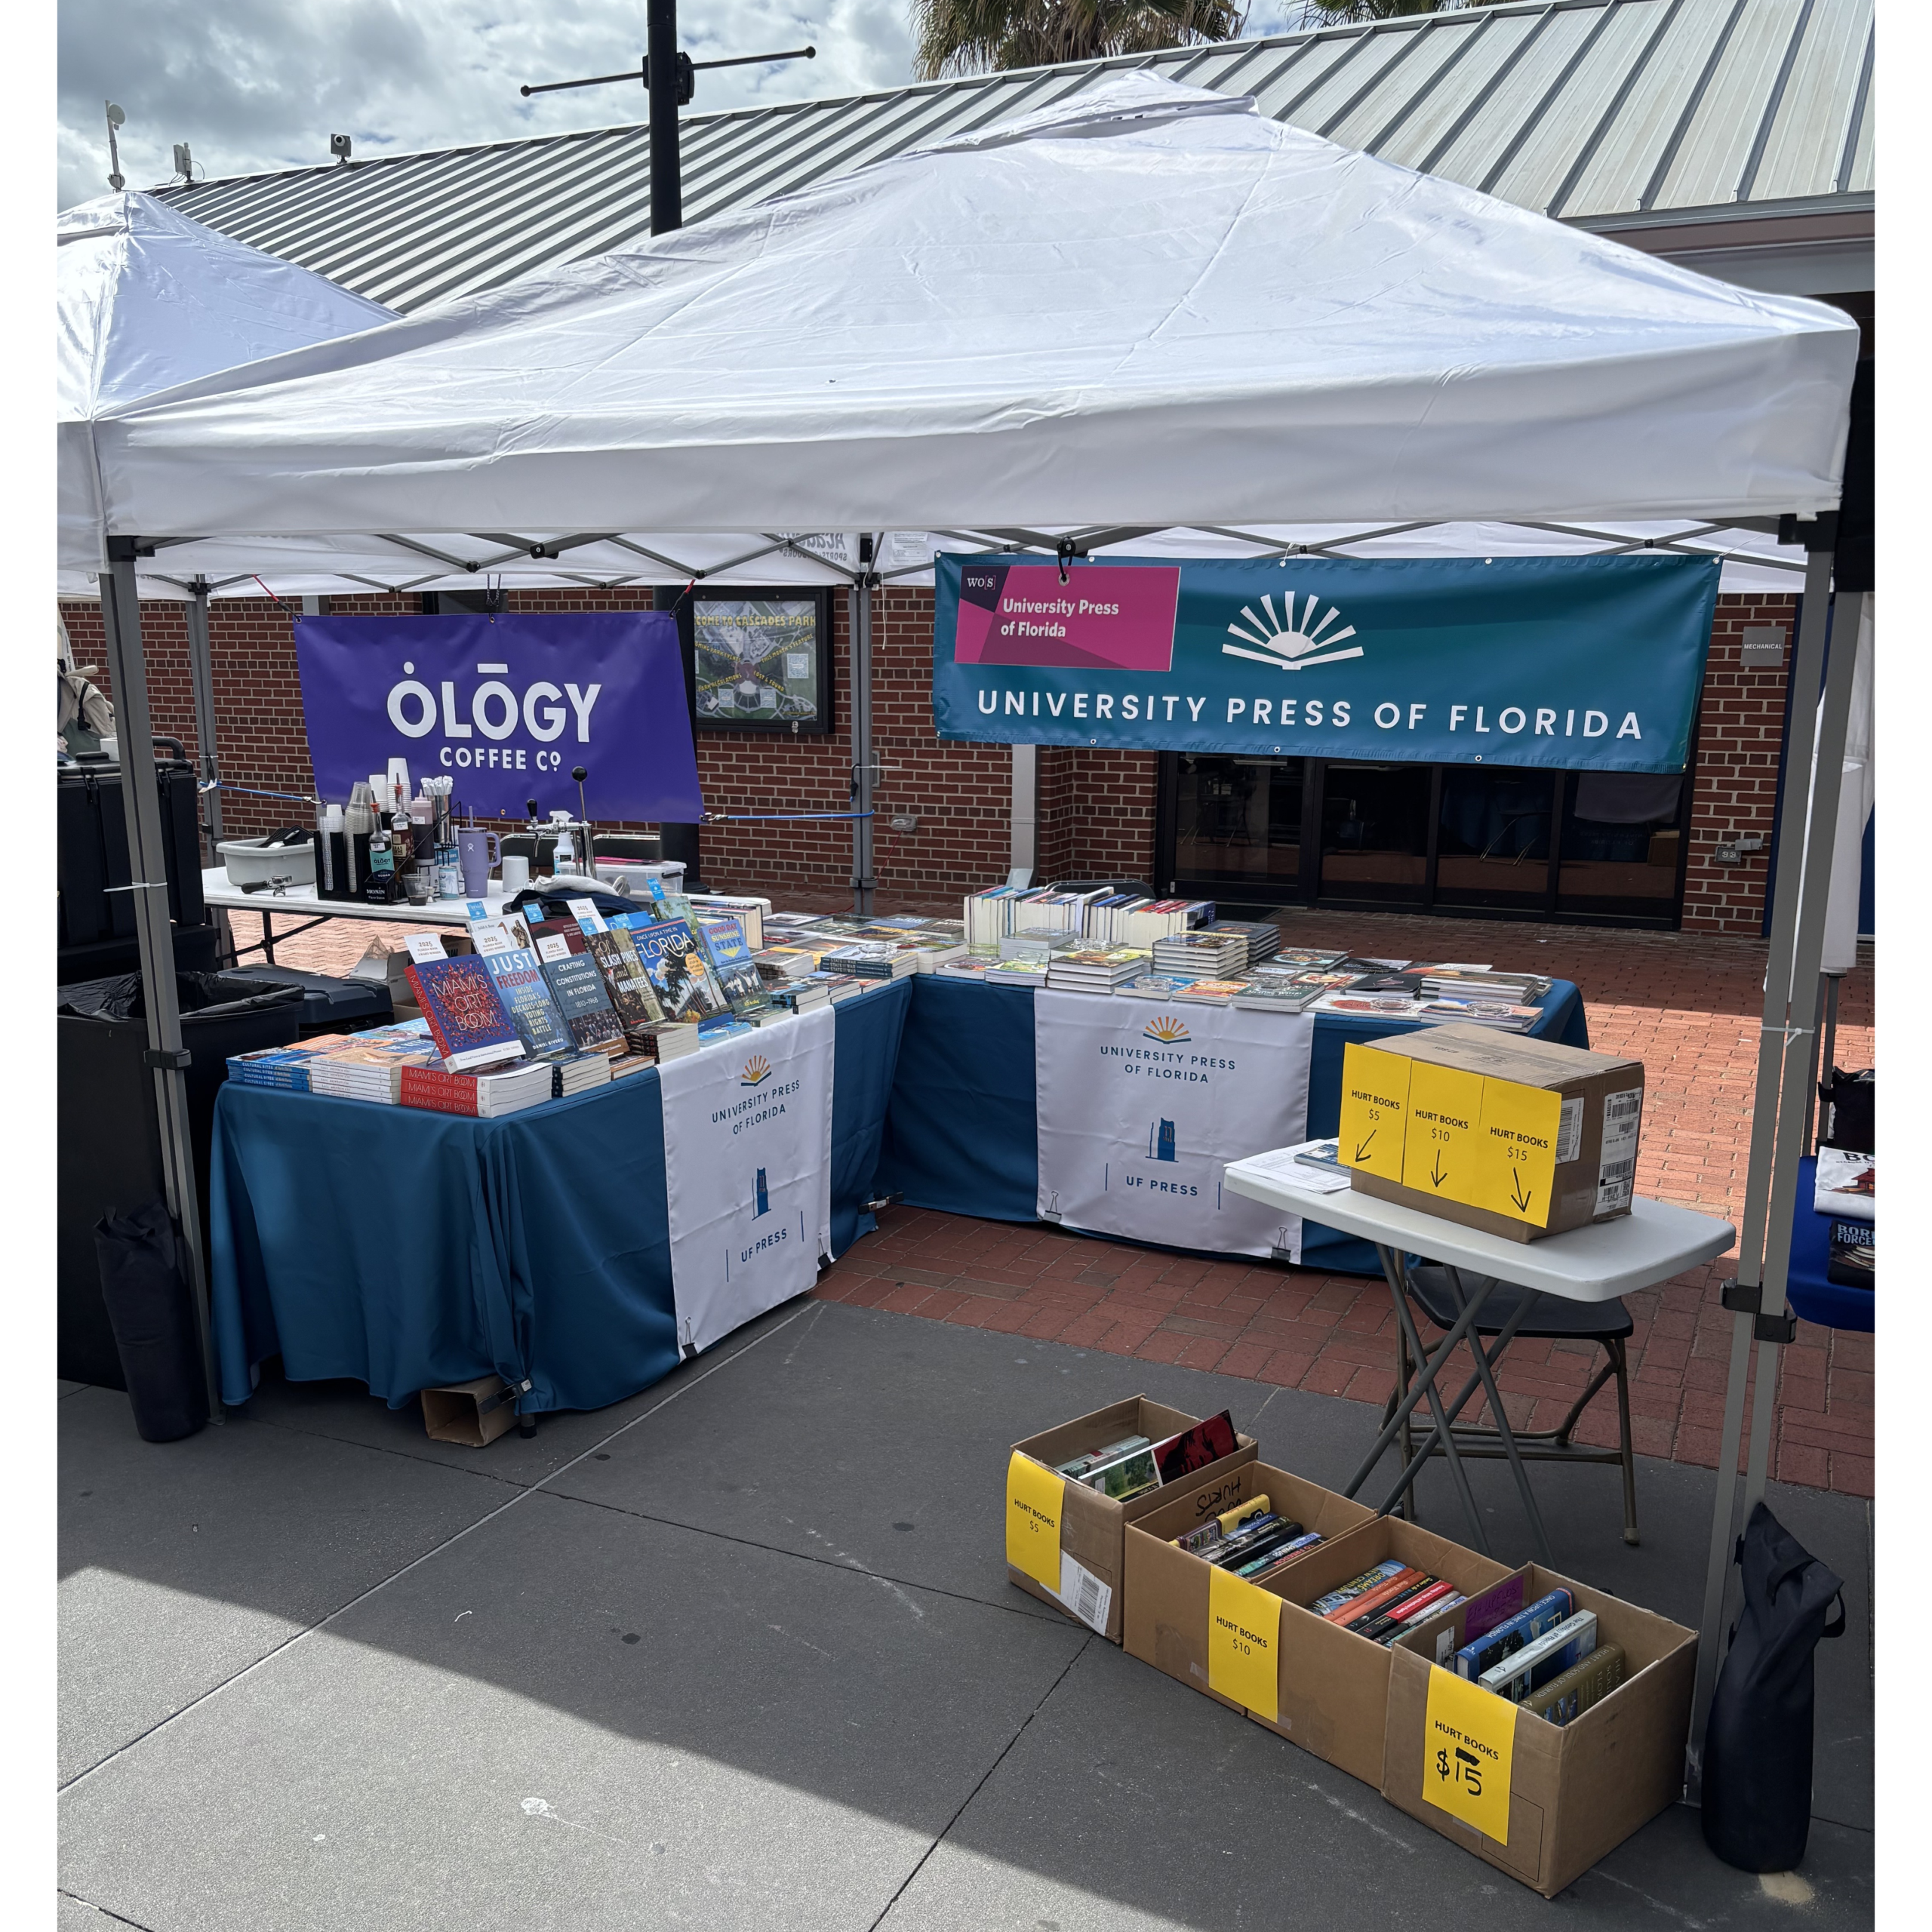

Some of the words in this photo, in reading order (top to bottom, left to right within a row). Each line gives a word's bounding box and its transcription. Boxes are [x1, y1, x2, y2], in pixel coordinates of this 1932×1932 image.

[1003, 598, 1075, 617] University
[1078, 599, 1120, 615] Press
[721, 616, 733, 626] TO
[736, 615, 786, 626] CASCADES
[789, 616, 816, 626] PARK
[1000, 620, 1016, 636] of
[1017, 621, 1066, 638] Florida
[761, 654, 773, 663] THIS
[772, 645, 792, 659] MONTH'S
[792, 632, 814, 648] FEATURE
[724, 651, 741, 663] EVENTS
[698, 681, 711, 692] PARK
[710, 672, 743, 688] REGULATIONS
[753, 670, 765, 681] LOST
[769, 679, 785, 692] FOUND
[978, 690, 1206, 721] UNIVERSITY
[1227, 698, 1352, 727] PRESS
[1374, 703, 1427, 730] OF
[1449, 705, 1642, 740] FLORIDA
[439, 747, 527, 770] COFFEE
[709, 926, 725, 934] GOOD
[725, 922, 737, 931] DAY
[711, 930, 740, 943] SUNSHINE
[635, 931, 695, 958] FLORIDA
[715, 937, 743, 952] STATE
[492, 952, 533, 975] JUST
[558, 959, 586, 972] CRAFTING
[599, 952, 621, 968] SLASH
[620, 949, 638, 965] PINES
[496, 968, 540, 989] FREEDOM
[556, 970, 597, 986] CONSTITUTIONS
[615, 964, 629, 979] and
[432, 974, 488, 997] MIAMI'S
[515, 985, 534, 995] INSIDE
[574, 983, 597, 995] FLORIDA
[617, 976, 649, 994] MANATEES
[511, 998, 551, 1014] DECADES-LONG
[514, 992, 541, 1004] FLORIDA'S
[410, 974, 429, 1010] MIAMI'S
[434, 1028, 450, 1057] BOOM
[455, 1009, 499, 1031] BOOM
[524, 1008, 545, 1019] VOTING
[528, 1017, 549, 1027] RIGHTS
[531, 1024, 552, 1035] BATTLE
[1100, 1046, 1184, 1063] UNIVERSITY
[1191, 1056, 1235, 1070] PRESS
[409, 1069, 436, 1081] MIAMI'S
[454, 1076, 475, 1088] BOOM
[1124, 1063, 1141, 1075] OF
[1148, 1067, 1208, 1084] FLORIDA
[408, 1082, 436, 1095] MIAMI'S
[454, 1090, 475, 1101] BOOM
[1351, 1089, 1372, 1103] HURT
[1373, 1094, 1401, 1110] BOOKS
[408, 1095, 437, 1108] MIAMI'S
[454, 1103, 475, 1115] BOOM
[712, 1092, 768, 1124] UNIVERSITY
[771, 1079, 800, 1099] PRESS
[733, 1121, 743, 1135] OF
[746, 1103, 786, 1129] FLORIDA
[1368, 1109, 1380, 1121] $5
[1415, 1109, 1438, 1121] HURT
[1439, 1113, 1469, 1130] BOOKS
[1431, 1127, 1451, 1142] $10
[1490, 1126, 1514, 1140] HURT
[1516, 1132, 1549, 1149] BOOKS
[1507, 1146, 1528, 1162] $15
[1126, 1175, 1143, 1188] UF
[1150, 1181, 1198, 1196] PRESS
[741, 1247, 753, 1263] UF
[755, 1229, 787, 1254] PRESS
[1195, 1476, 1242, 1517] HURTS
[1014, 1498, 1032, 1515] HURT
[1032, 1509, 1056, 1528] BOOKS
[1029, 1520, 1040, 1534] $5
[1295, 1534, 1318, 1548] FLORIDA
[1303, 1544, 1315, 1552] TO
[1273, 1549, 1306, 1565] FREEDOM
[1338, 1576, 1365, 1593] CENTURY
[1357, 1572, 1386, 1590] DREAMS
[1373, 1581, 1389, 1592] Florida
[1382, 1585, 1399, 1596] Florida
[1529, 1601, 1543, 1613] UPON
[1542, 1595, 1555, 1605] ONCE
[1513, 1613, 1526, 1624] TIME
[1216, 1615, 1238, 1633] HURT
[1238, 1627, 1269, 1649] BOOKS
[1487, 1624, 1509, 1639] FLORIDA
[1556, 1620, 1577, 1635] Geology
[1232, 1638, 1251, 1657] $10
[1537, 1635, 1555, 1647] Florida
[1592, 1648, 1611, 1663] HEART
[1567, 1666, 1582, 1678] SOUL
[1580, 1659, 1593, 1670] AND
[1556, 1676, 1567, 1685] OF
[1534, 1681, 1558, 1699] FLORIDA
[1435, 1719, 1462, 1741] HURT
[1463, 1734, 1500, 1761] BOOKS
[1436, 1747, 1483, 1797] $15
